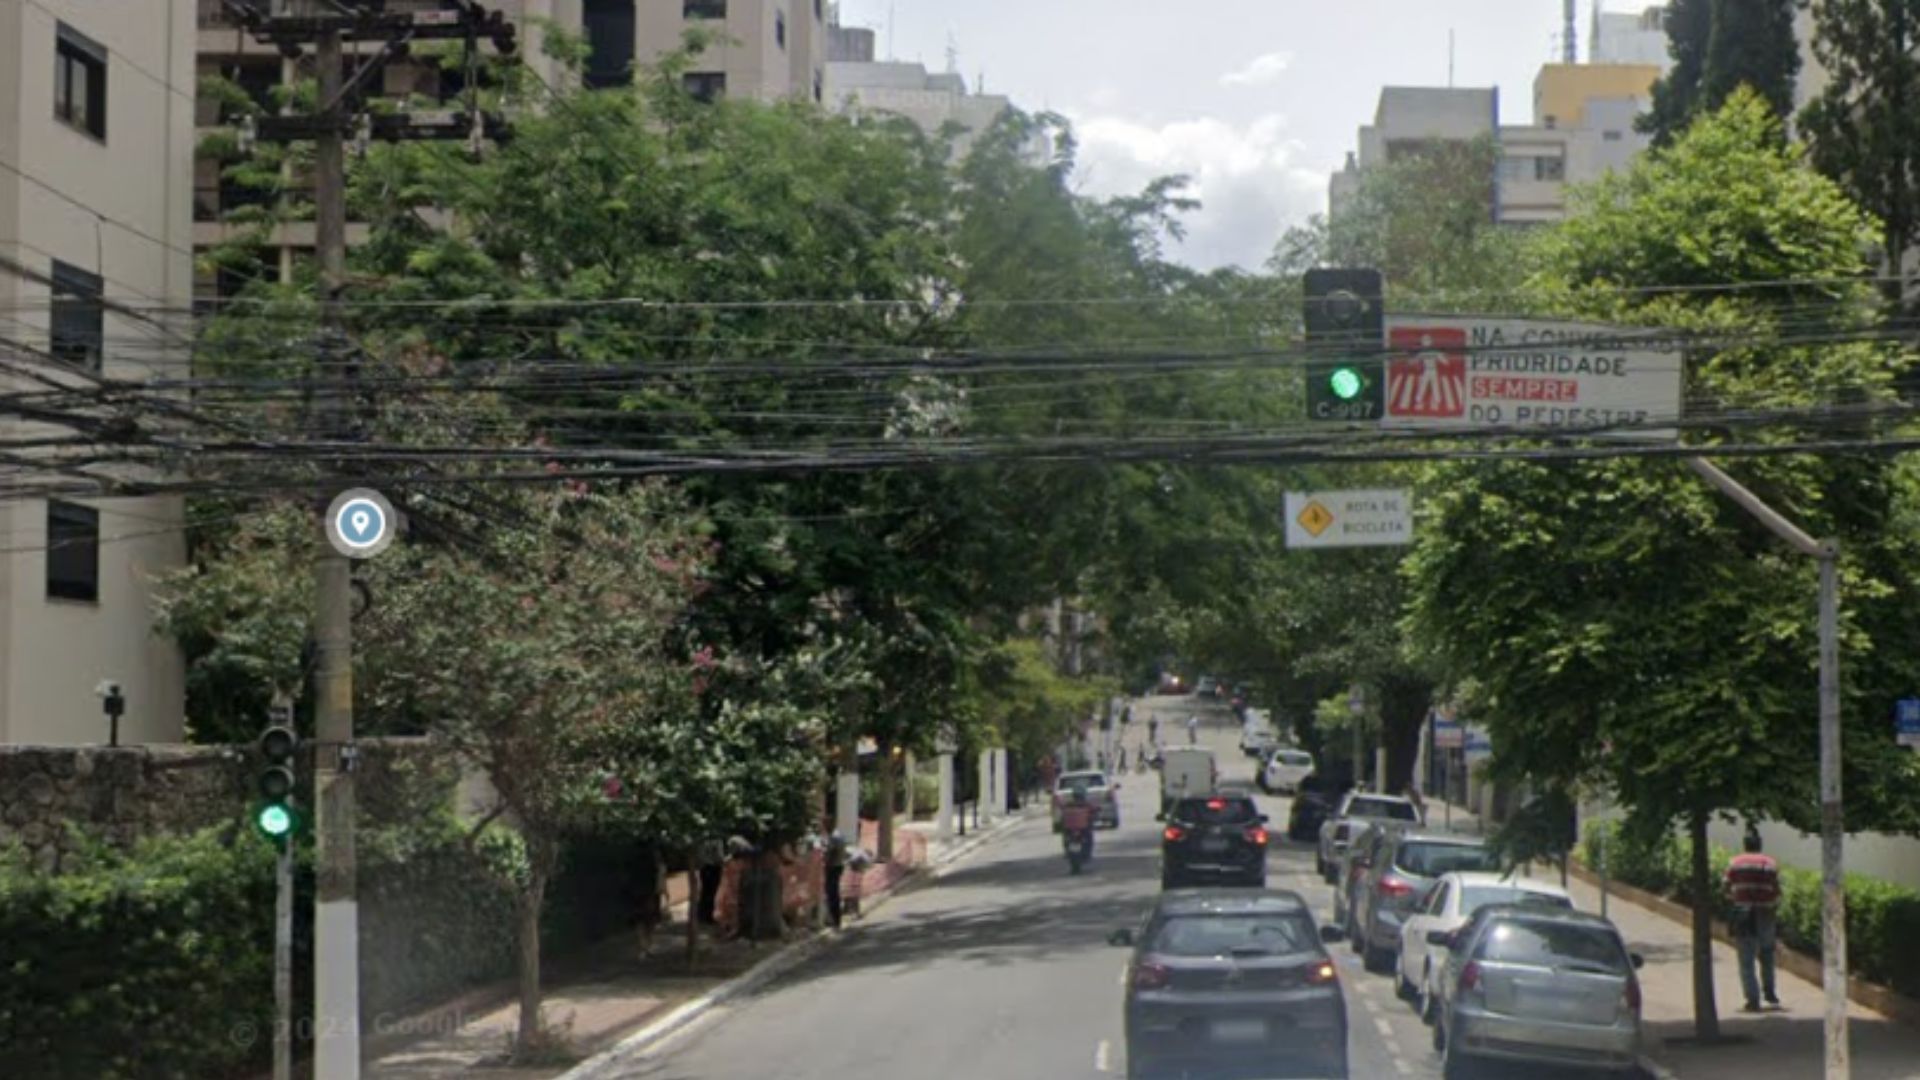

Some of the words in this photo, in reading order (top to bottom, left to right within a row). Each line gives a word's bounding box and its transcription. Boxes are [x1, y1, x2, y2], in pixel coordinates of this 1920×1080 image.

[1472, 326, 1504, 347] NA
[1471, 350, 1626, 376] PRIORIDADE
[1473, 378, 1577, 400] SEMPRE
[1470, 404, 1501, 424] DO
[1345, 501, 1378, 512] ROTA
[1383, 500, 1398, 512] DE
[1343, 521, 1402, 534] BICICLETA
